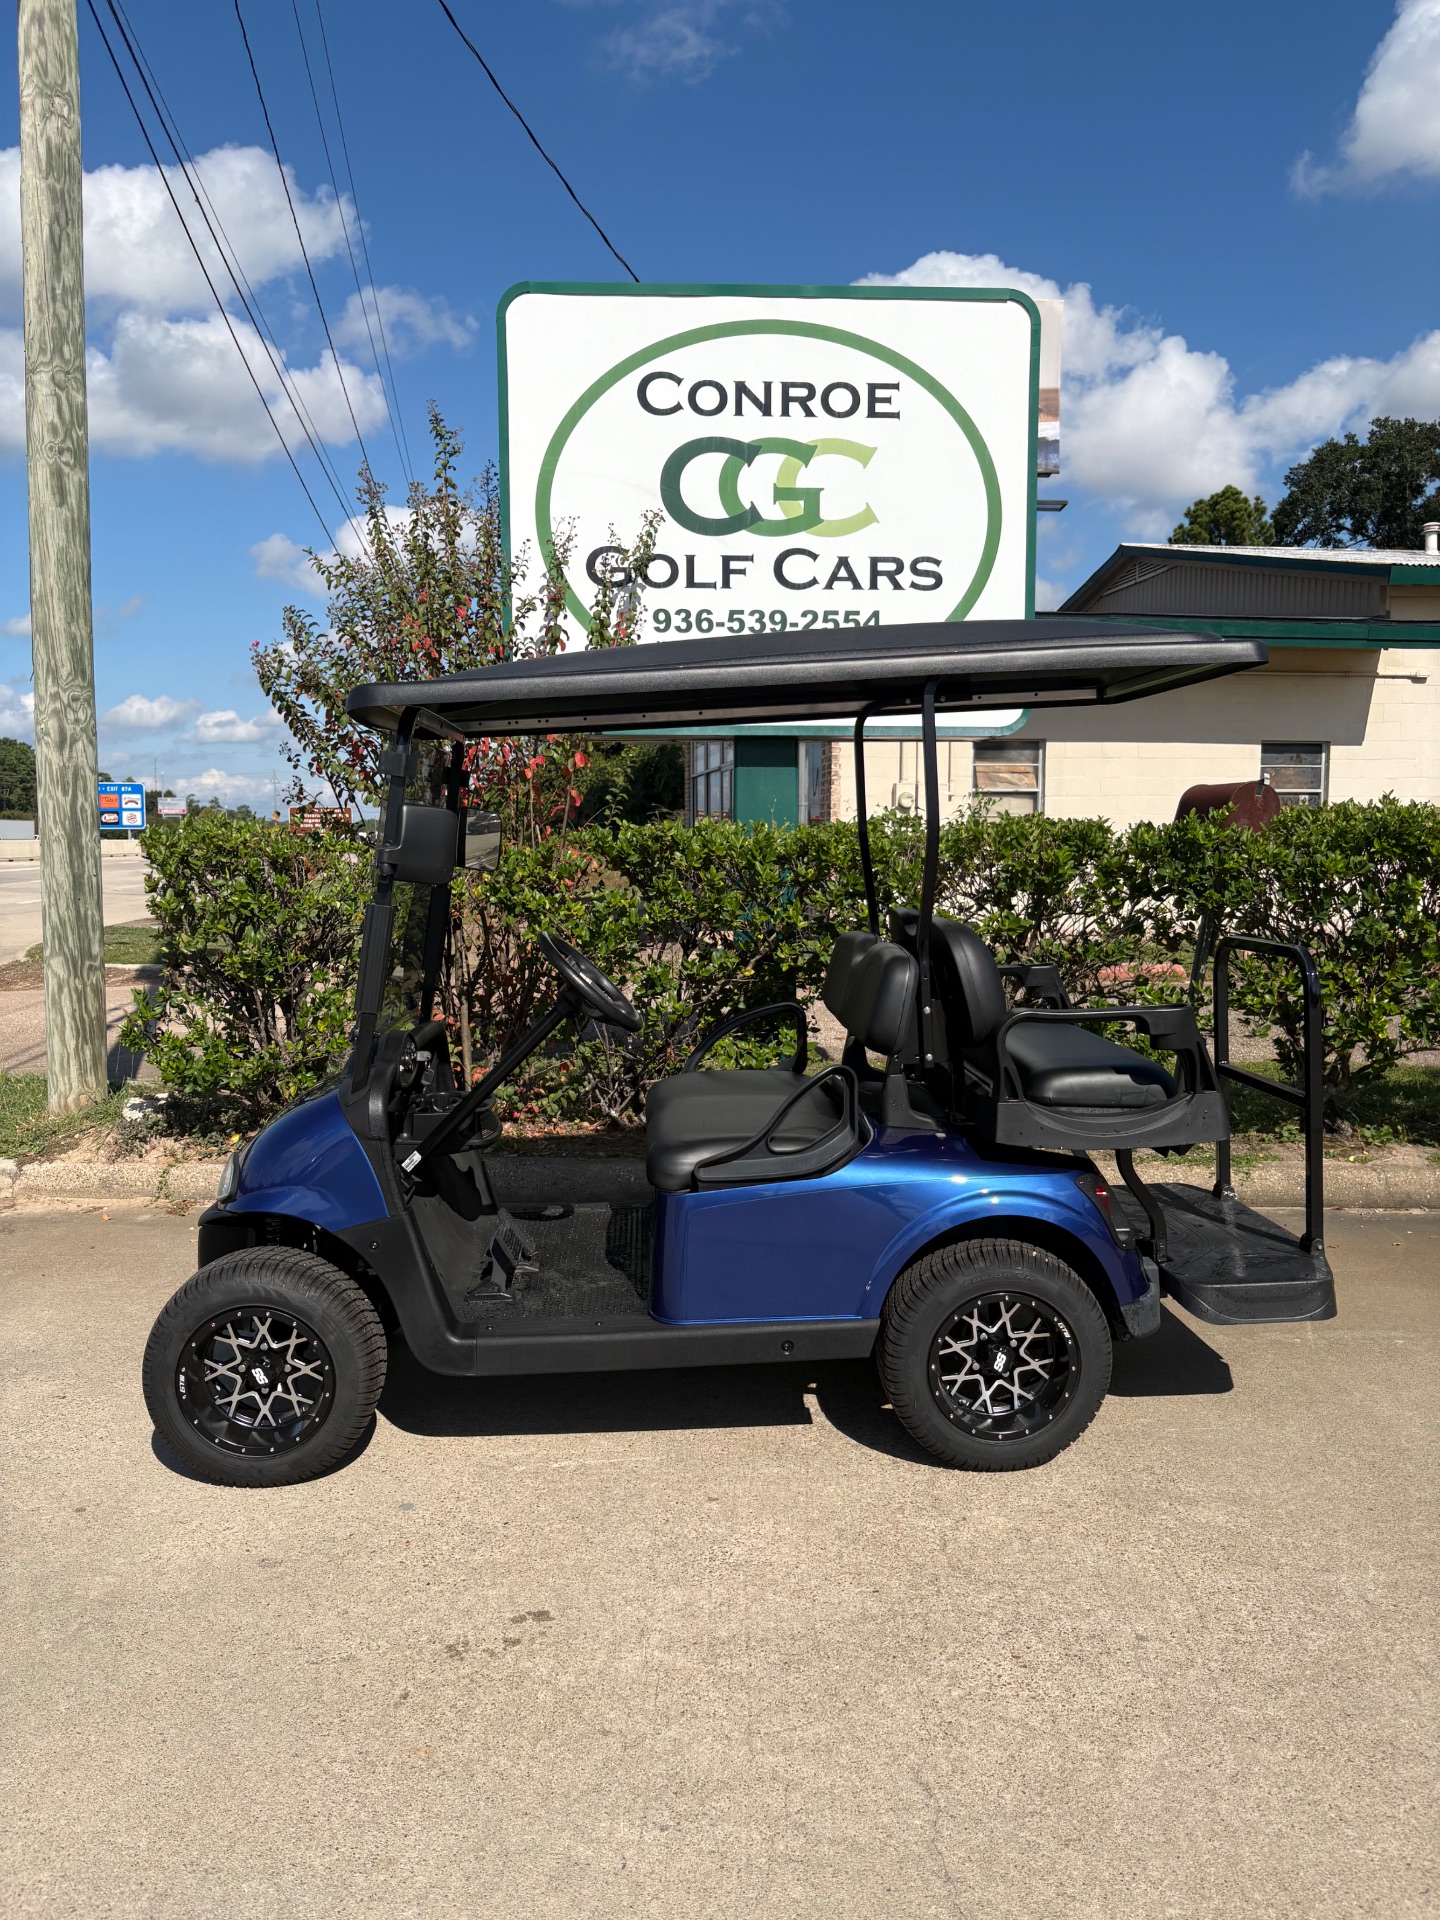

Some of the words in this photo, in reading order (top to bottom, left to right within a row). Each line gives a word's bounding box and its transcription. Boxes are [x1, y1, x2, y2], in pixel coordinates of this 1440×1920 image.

[637, 371, 901, 421] CONROE
[586, 545, 754, 591] GOLF
[773, 547, 944, 591] CARS
[652, 608, 881, 634] 936-539-2554
